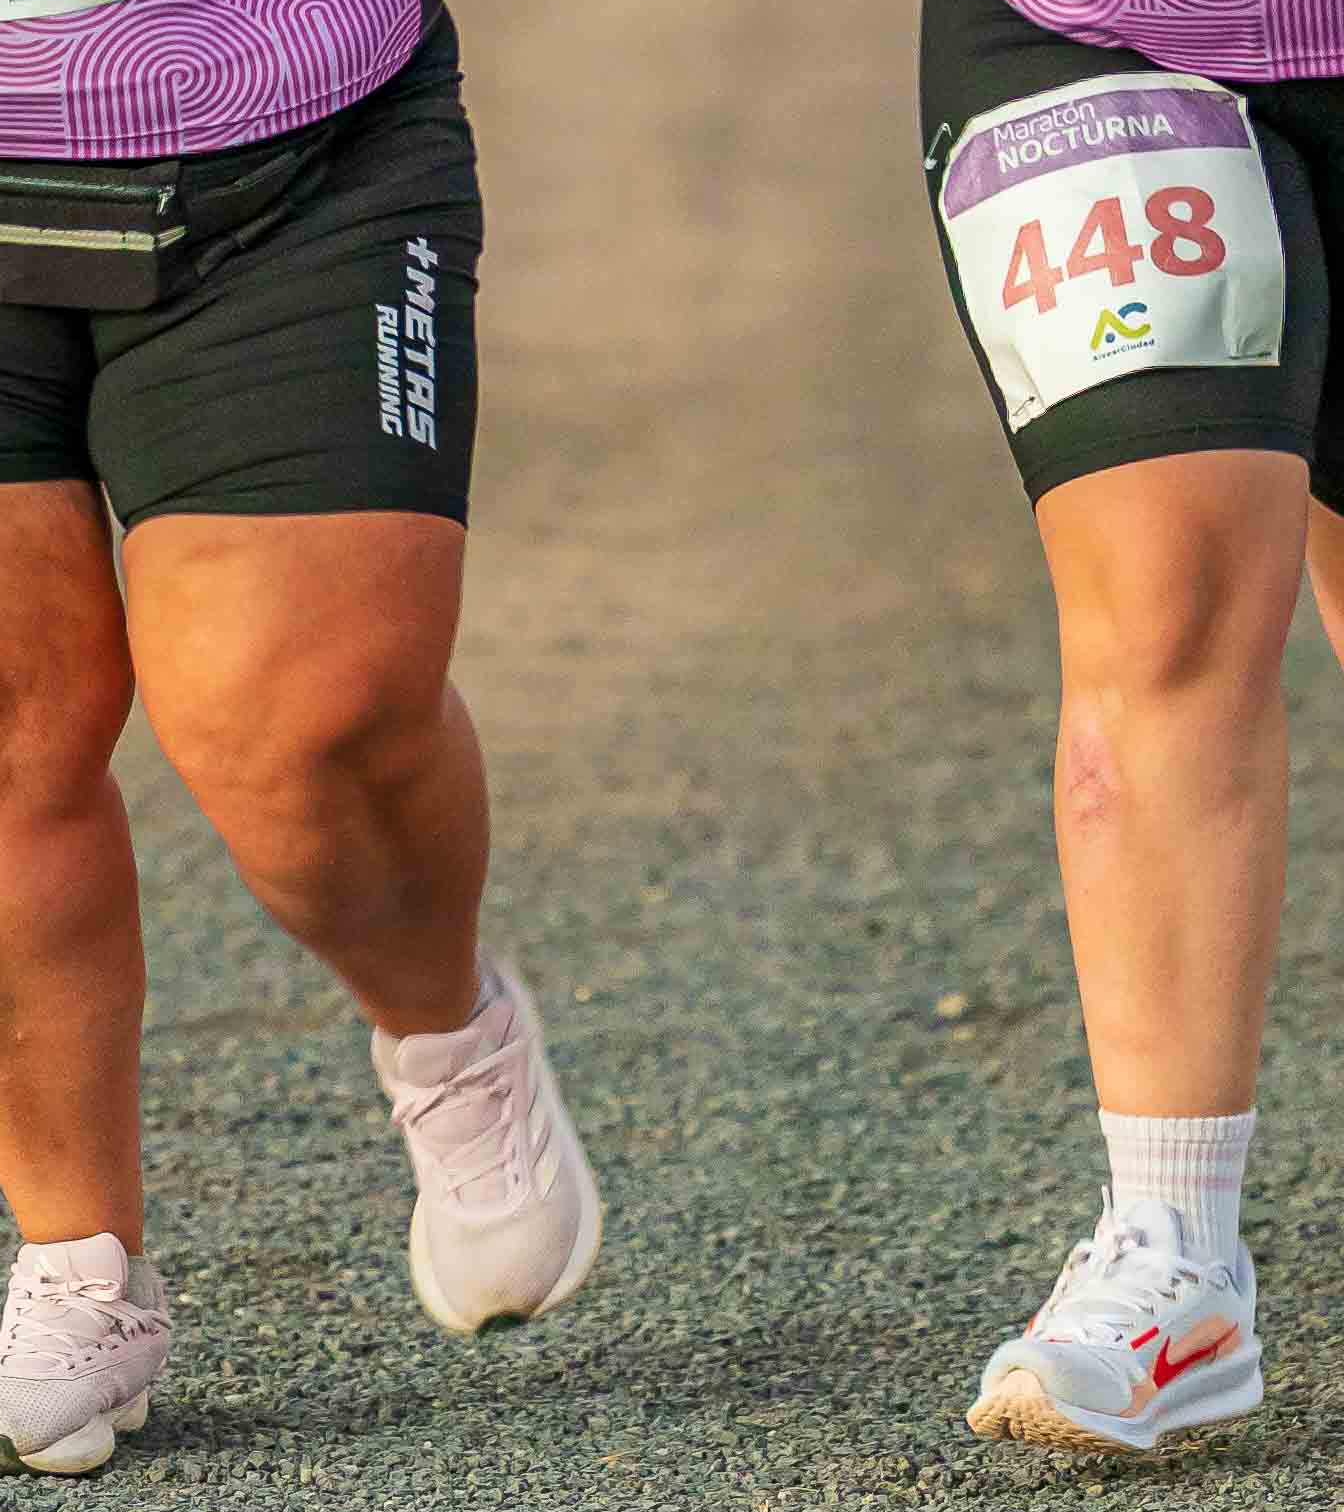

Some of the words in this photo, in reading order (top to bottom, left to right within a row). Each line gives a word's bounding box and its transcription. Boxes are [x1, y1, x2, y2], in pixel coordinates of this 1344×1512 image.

[997, 112, 1175, 174] NOCTURNA
[1002, 186, 1226, 314] 448
[375, 303, 404, 438] RUNNING
[1090, 302, 1150, 351] AC
